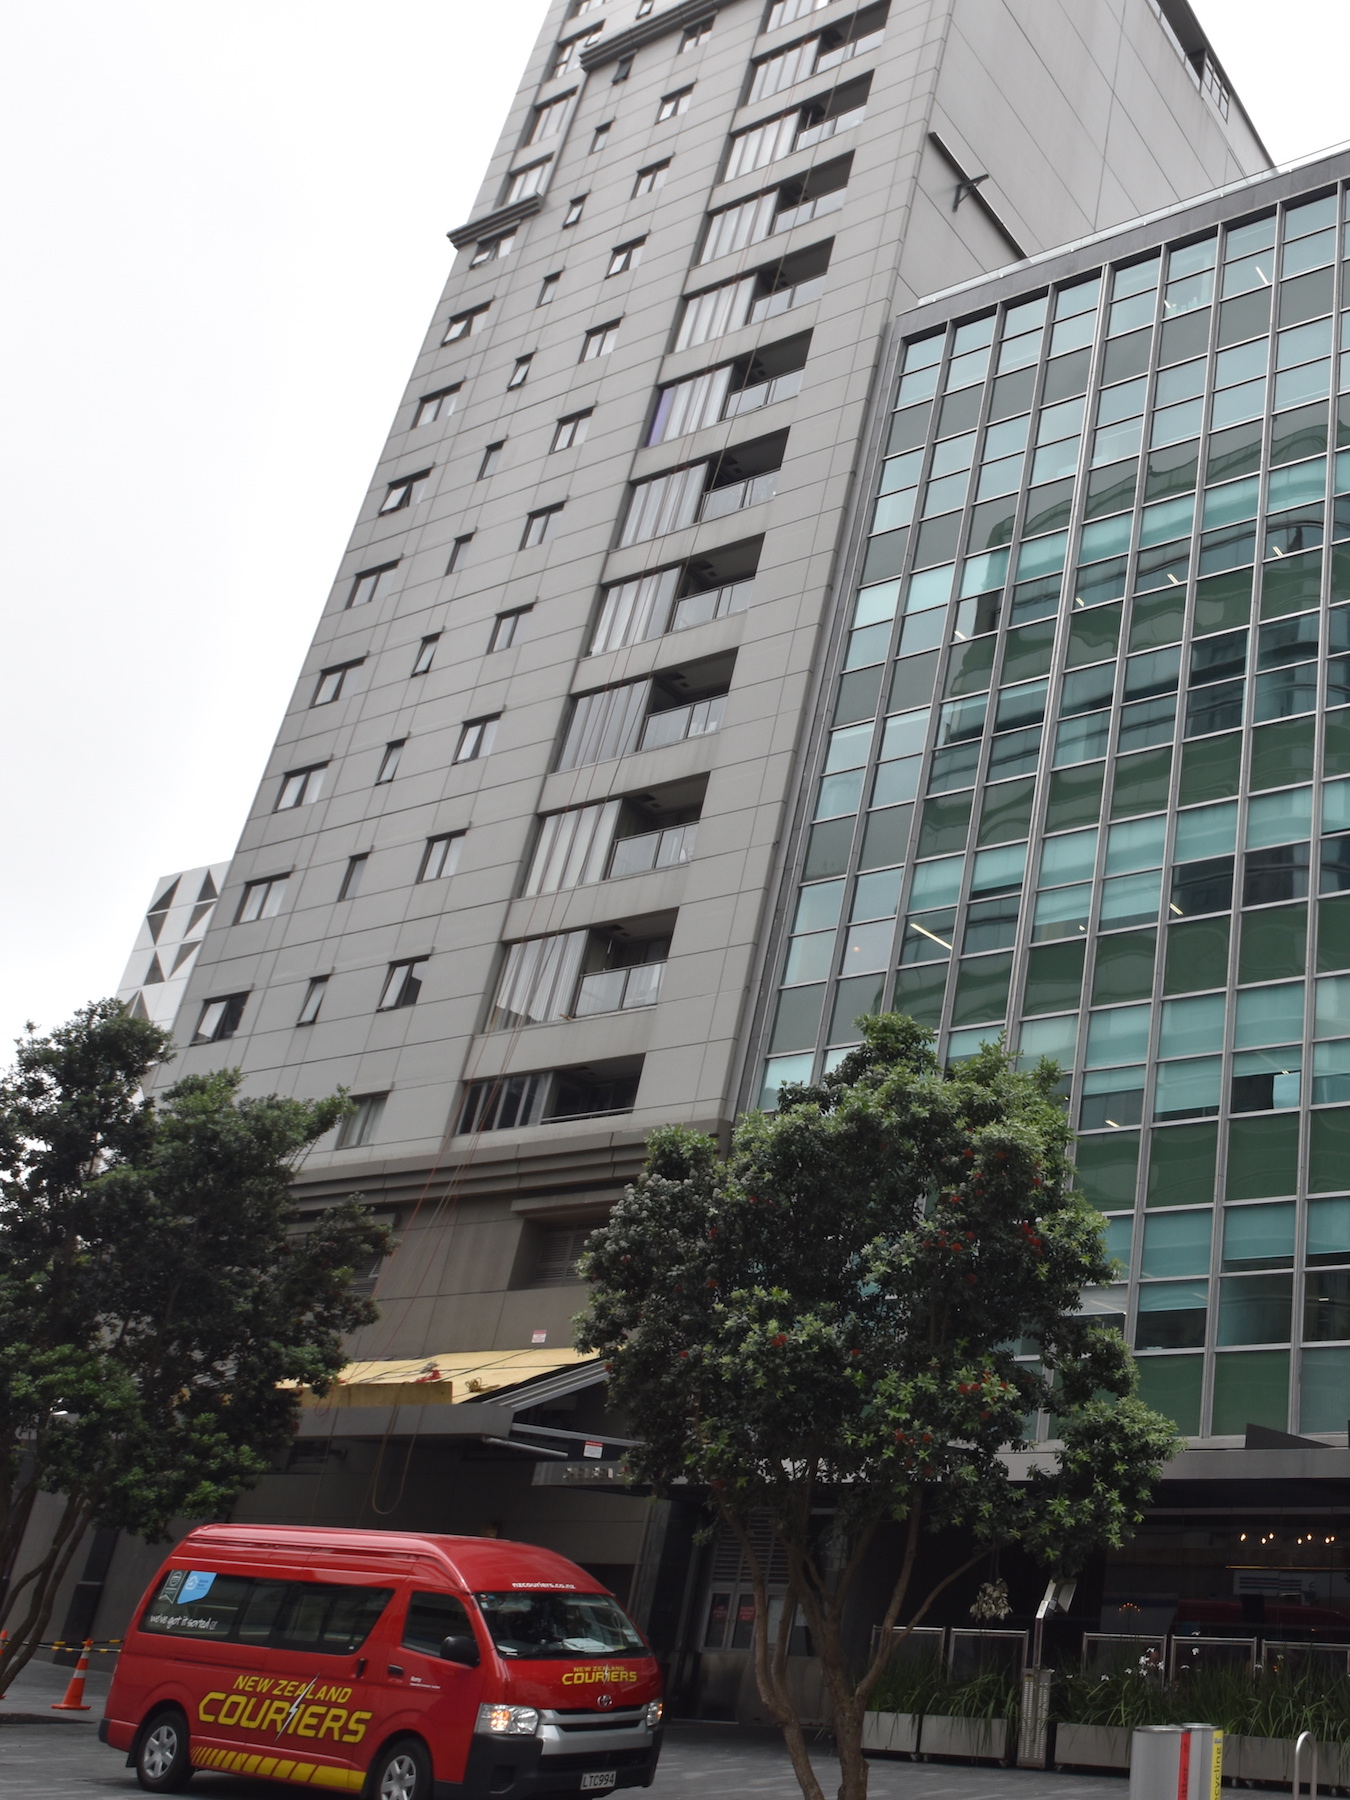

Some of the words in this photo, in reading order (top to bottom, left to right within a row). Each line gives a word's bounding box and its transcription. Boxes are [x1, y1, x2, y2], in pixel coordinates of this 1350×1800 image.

[233, 1675, 275, 1693] NEW
[272, 1680, 352, 1703] ZEALAND
[562, 1671, 637, 1685] COURIERS
[198, 1691, 373, 1743] COURIERS
